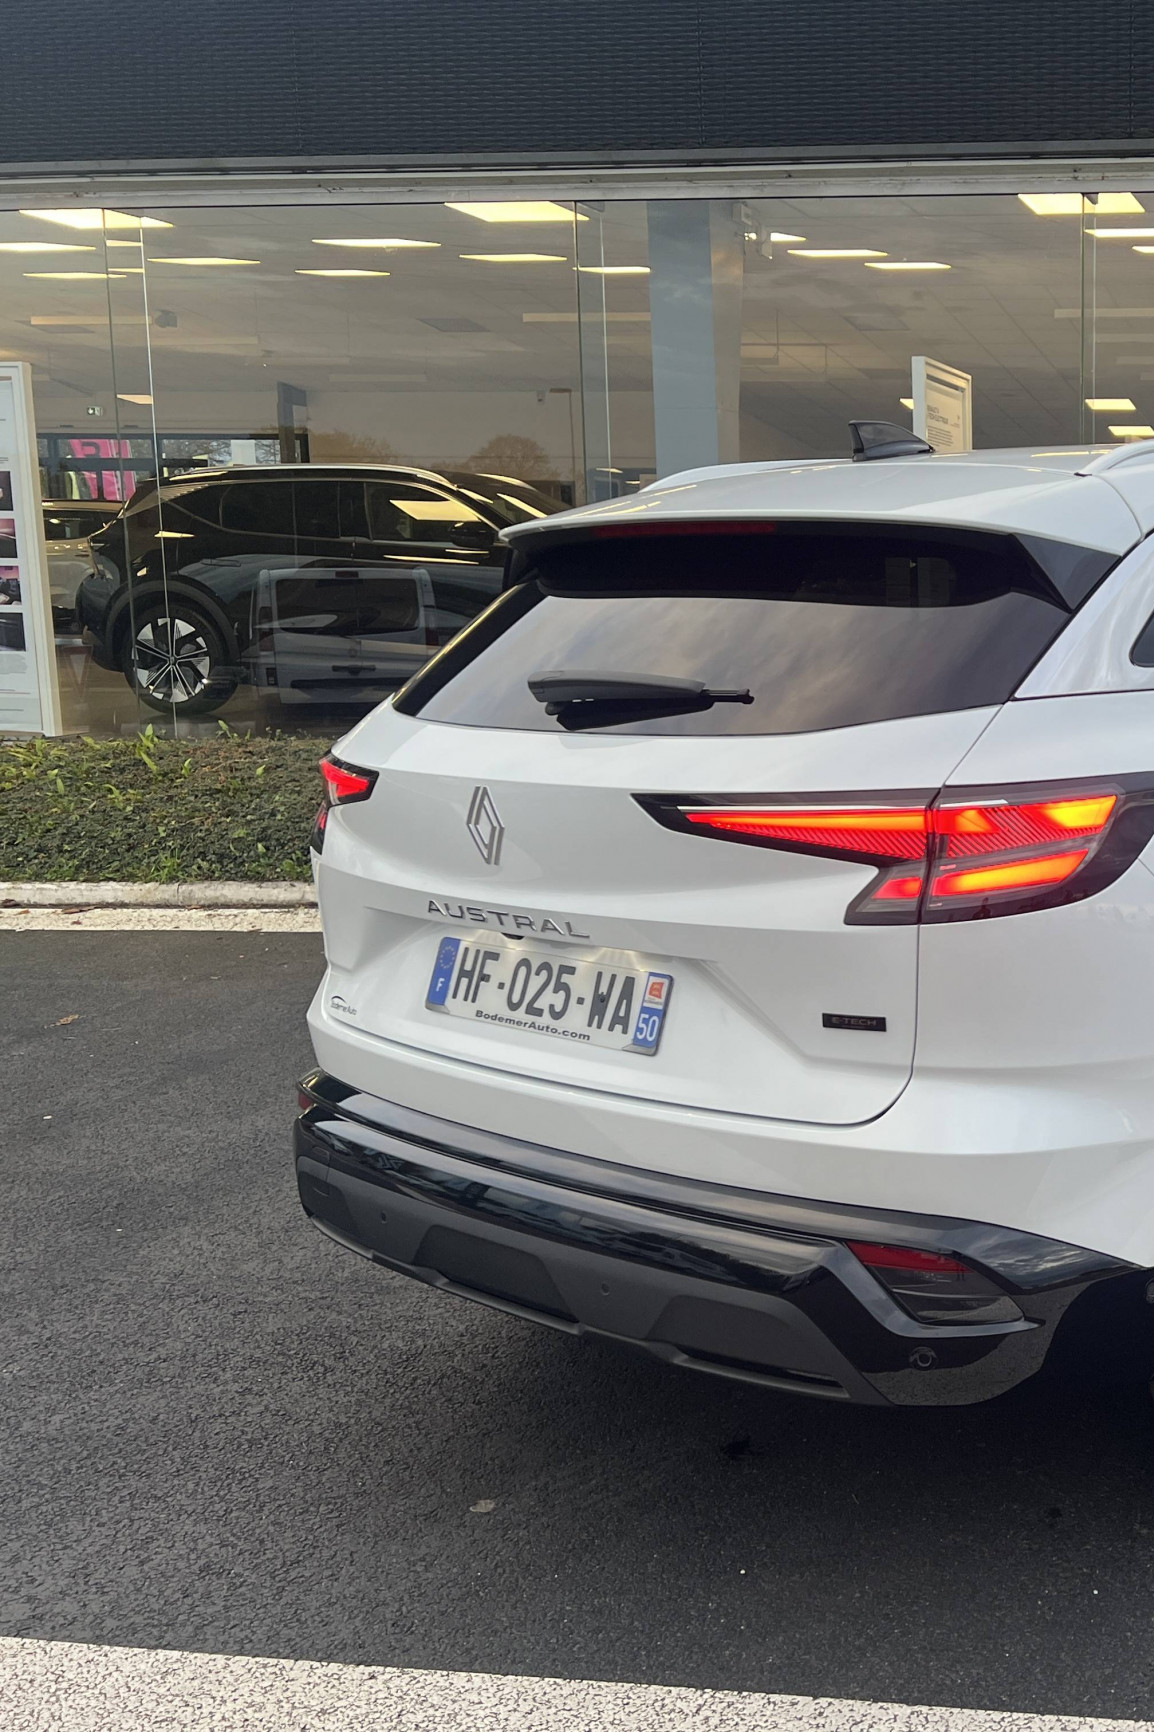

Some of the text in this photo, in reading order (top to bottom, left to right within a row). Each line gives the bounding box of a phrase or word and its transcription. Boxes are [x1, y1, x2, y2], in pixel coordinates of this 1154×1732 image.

[427, 899, 591, 940] AUSTRAL
[435, 977, 446, 992] F
[451, 946, 636, 1035] HF-025-WA
[474, 1009, 592, 1042] BodemerAuto.com
[635, 1013, 660, 1042] 50
[831, 1016, 877, 1027] E-TECH
